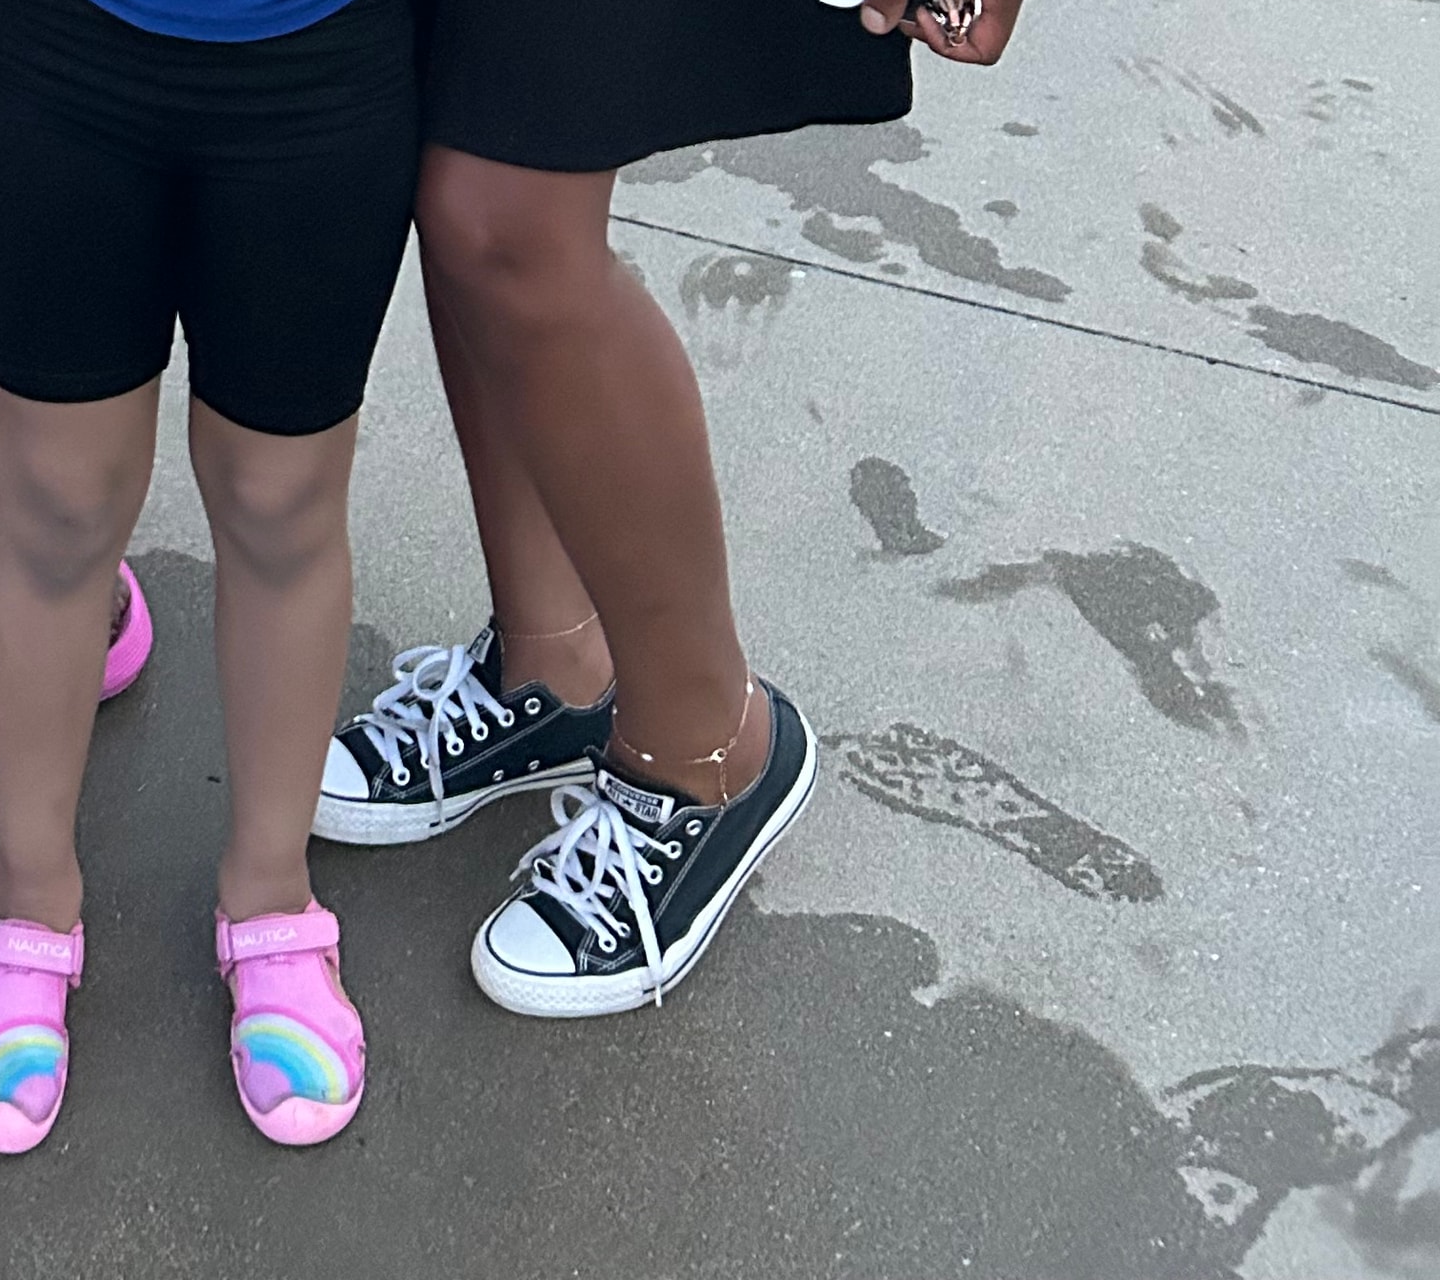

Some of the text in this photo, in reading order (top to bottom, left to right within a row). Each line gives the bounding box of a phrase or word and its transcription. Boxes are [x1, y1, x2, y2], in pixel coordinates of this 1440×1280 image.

[606, 786, 659, 820] ALL STAR
[610, 780, 659, 806] CONVERSE
[7, 937, 71, 959] NAUTICA
[231, 927, 298, 947] NAUTICA
